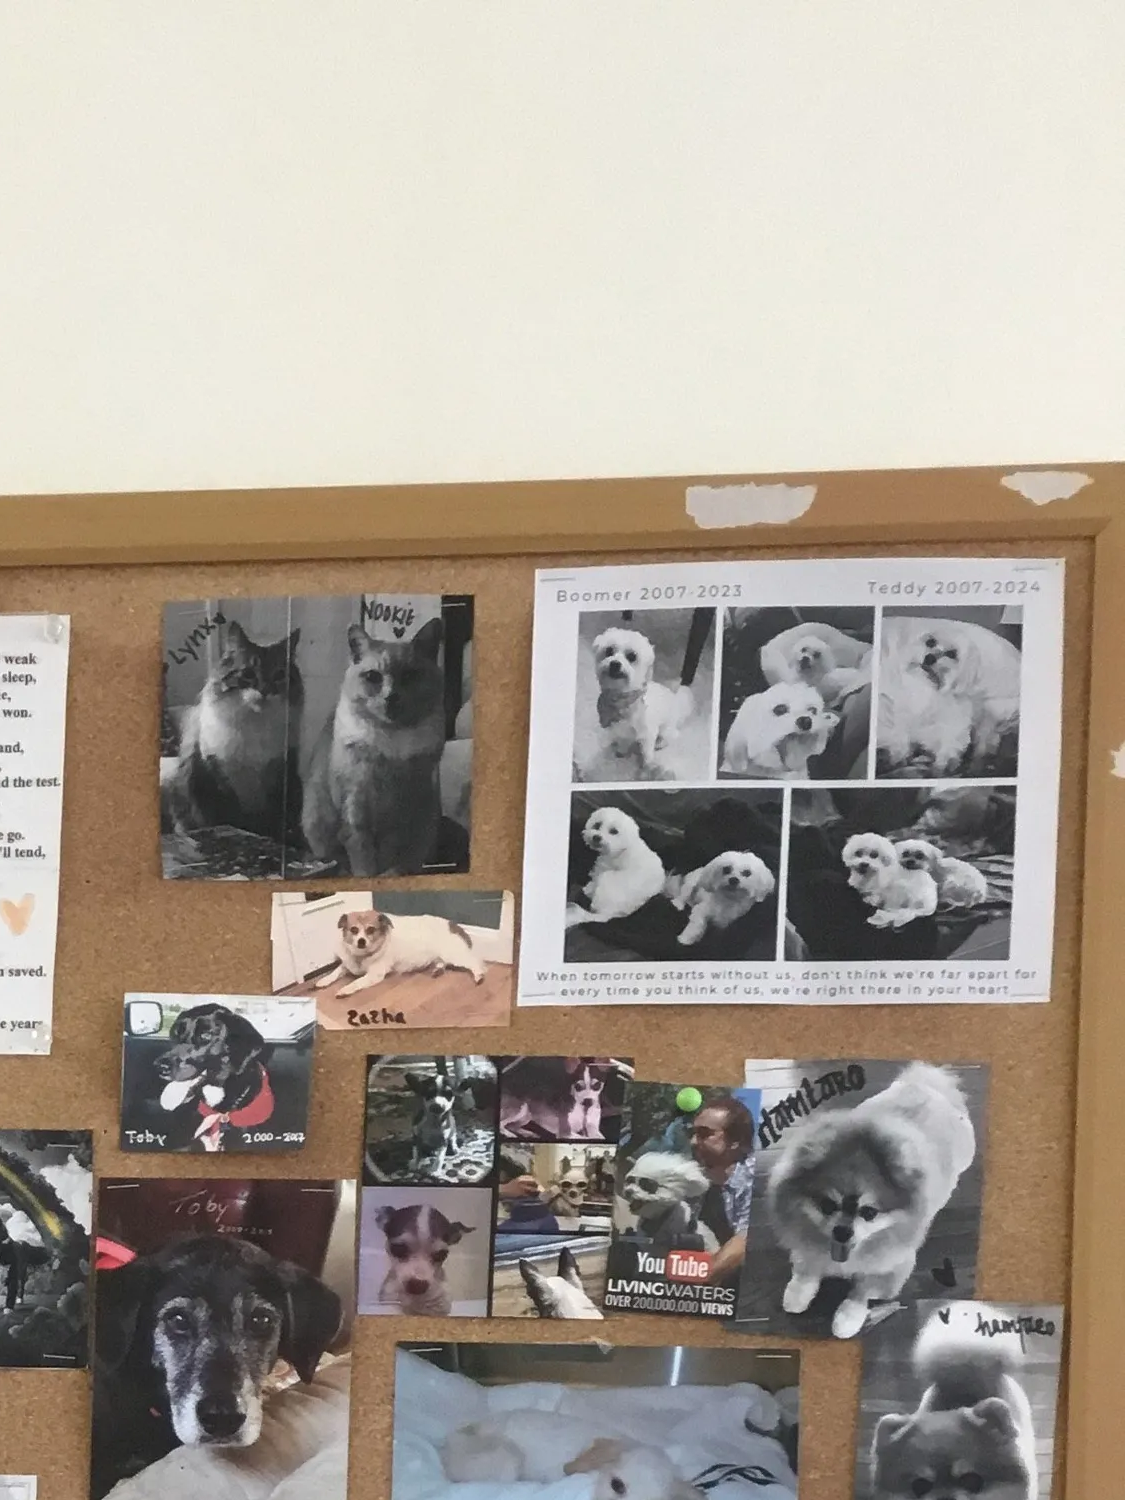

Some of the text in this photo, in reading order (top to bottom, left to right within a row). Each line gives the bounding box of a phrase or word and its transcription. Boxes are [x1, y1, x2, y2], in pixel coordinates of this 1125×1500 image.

[556, 585, 742, 602] Boomer 2007-2023
[869, 581, 1041, 599] Teddy 2007-2024
[4, 653, 37, 665] weak
[2, 671, 37, 686] sleep,
[13, 777, 33, 788] the
[36, 777, 61, 787] test.
[536, 972, 578, 982] When
[583, 972, 656, 981] tomorrow
[661, 971, 705, 981] starts
[710, 970, 769, 980] without
[801, 970, 841, 980] don't
[847, 970, 888, 980] think
[893, 970, 935, 980] we're
[940, 970, 962, 980] far
[968, 971, 1009, 982] apart
[1015, 969, 1037, 979] for
[560, 988, 601, 998] every
[606, 987, 641, 996] time
[645, 987, 673, 997] you
[677, 985, 719, 996] think
[723, 985, 738, 995] of
[770, 986, 811, 996] we're
[816, 985, 855, 998] right
[860, 986, 902, 995] there
[907, 984, 923, 995] in
[928, 987, 962, 996] your
[968, 986, 1009, 995] heart
[125, 1129, 167, 1146] Toby
[169, 1189, 229, 1223] Toby
[605, 1294, 631, 1307] OVER
[700, 1303, 734, 1316] VIEWS
